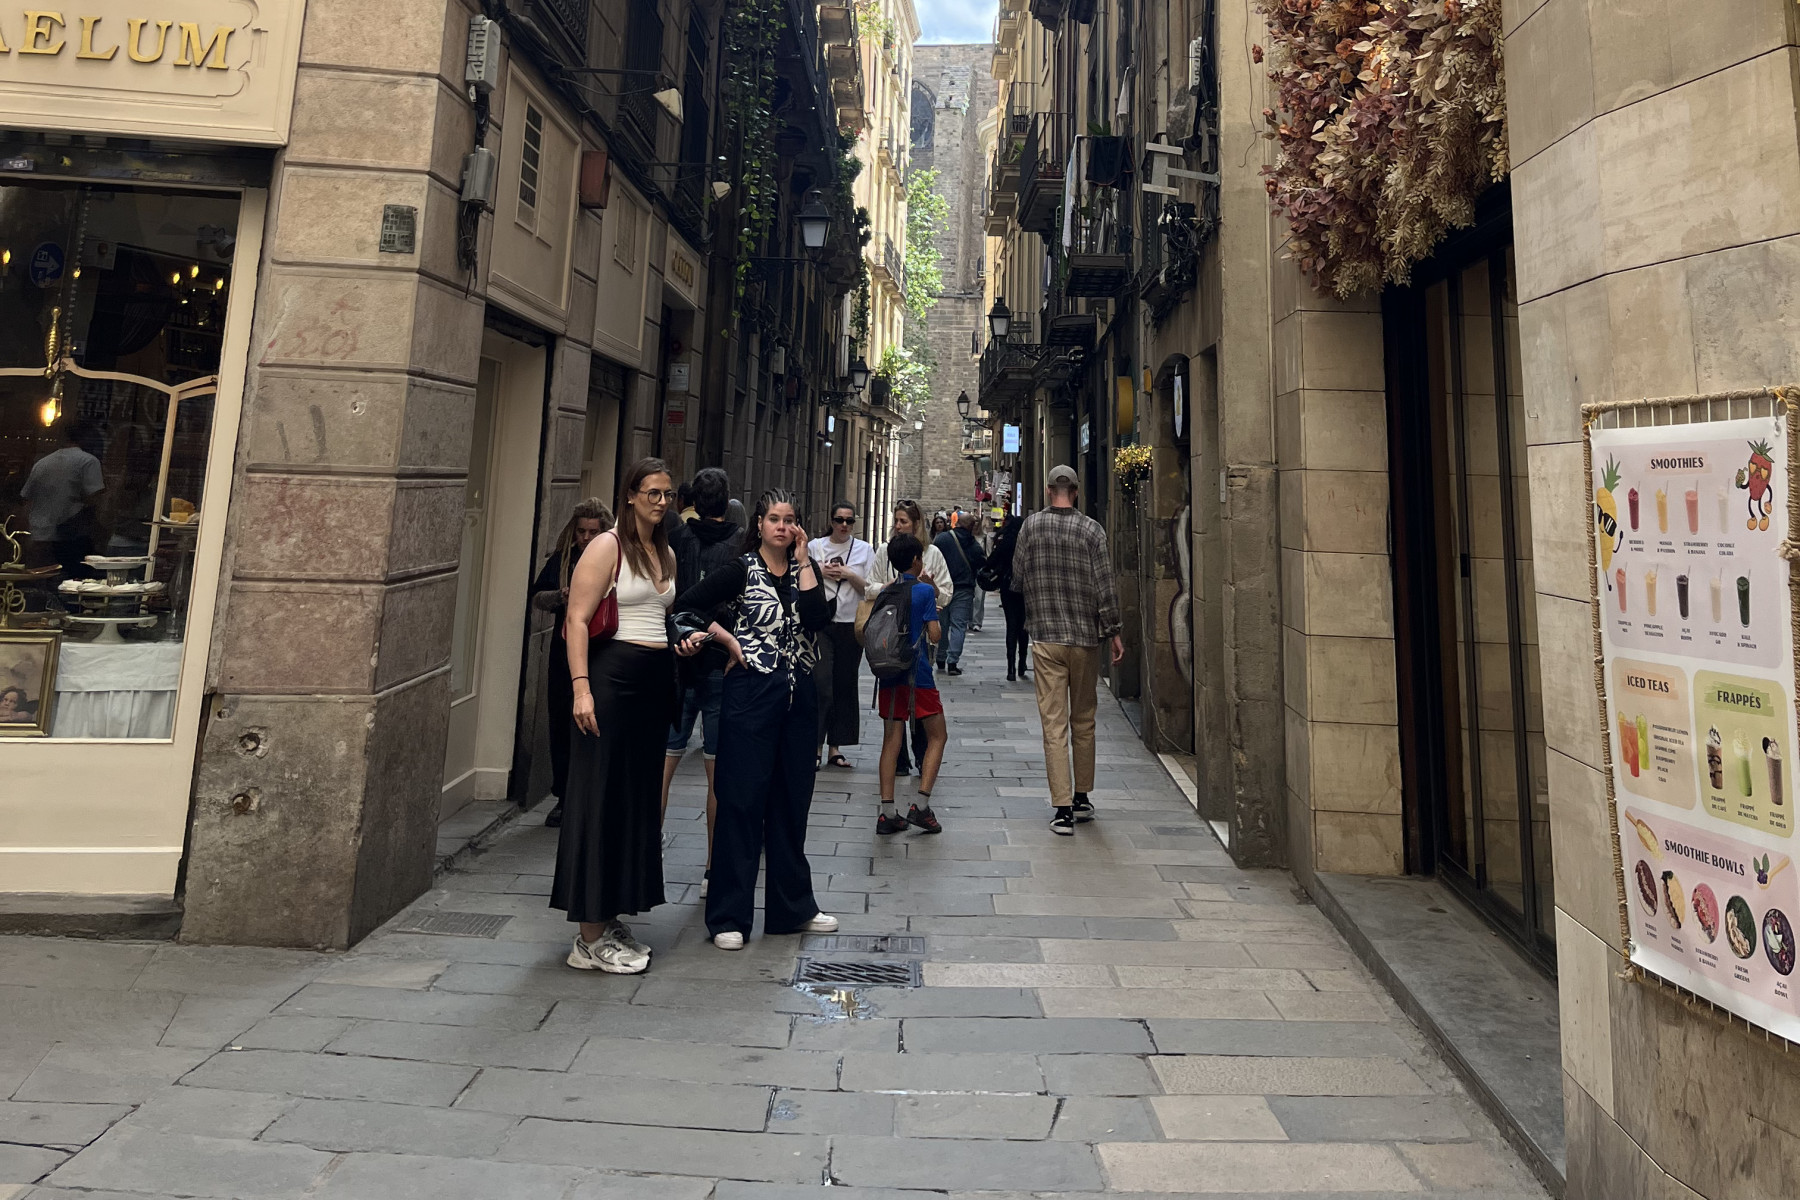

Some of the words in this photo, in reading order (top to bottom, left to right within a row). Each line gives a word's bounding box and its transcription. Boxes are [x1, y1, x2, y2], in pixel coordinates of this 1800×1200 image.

[0, 10, 236, 70] ELUM
[1651, 457, 1704, 470] SMOOTHIES
[1627, 675, 1646, 688] ICED
[1647, 678, 1669, 693] TEAS
[1717, 690, 1761, 709] FRAPPÉS
[1664, 839, 1710, 865] SMOOTHIE
[1711, 854, 1745, 877] BOWLS
